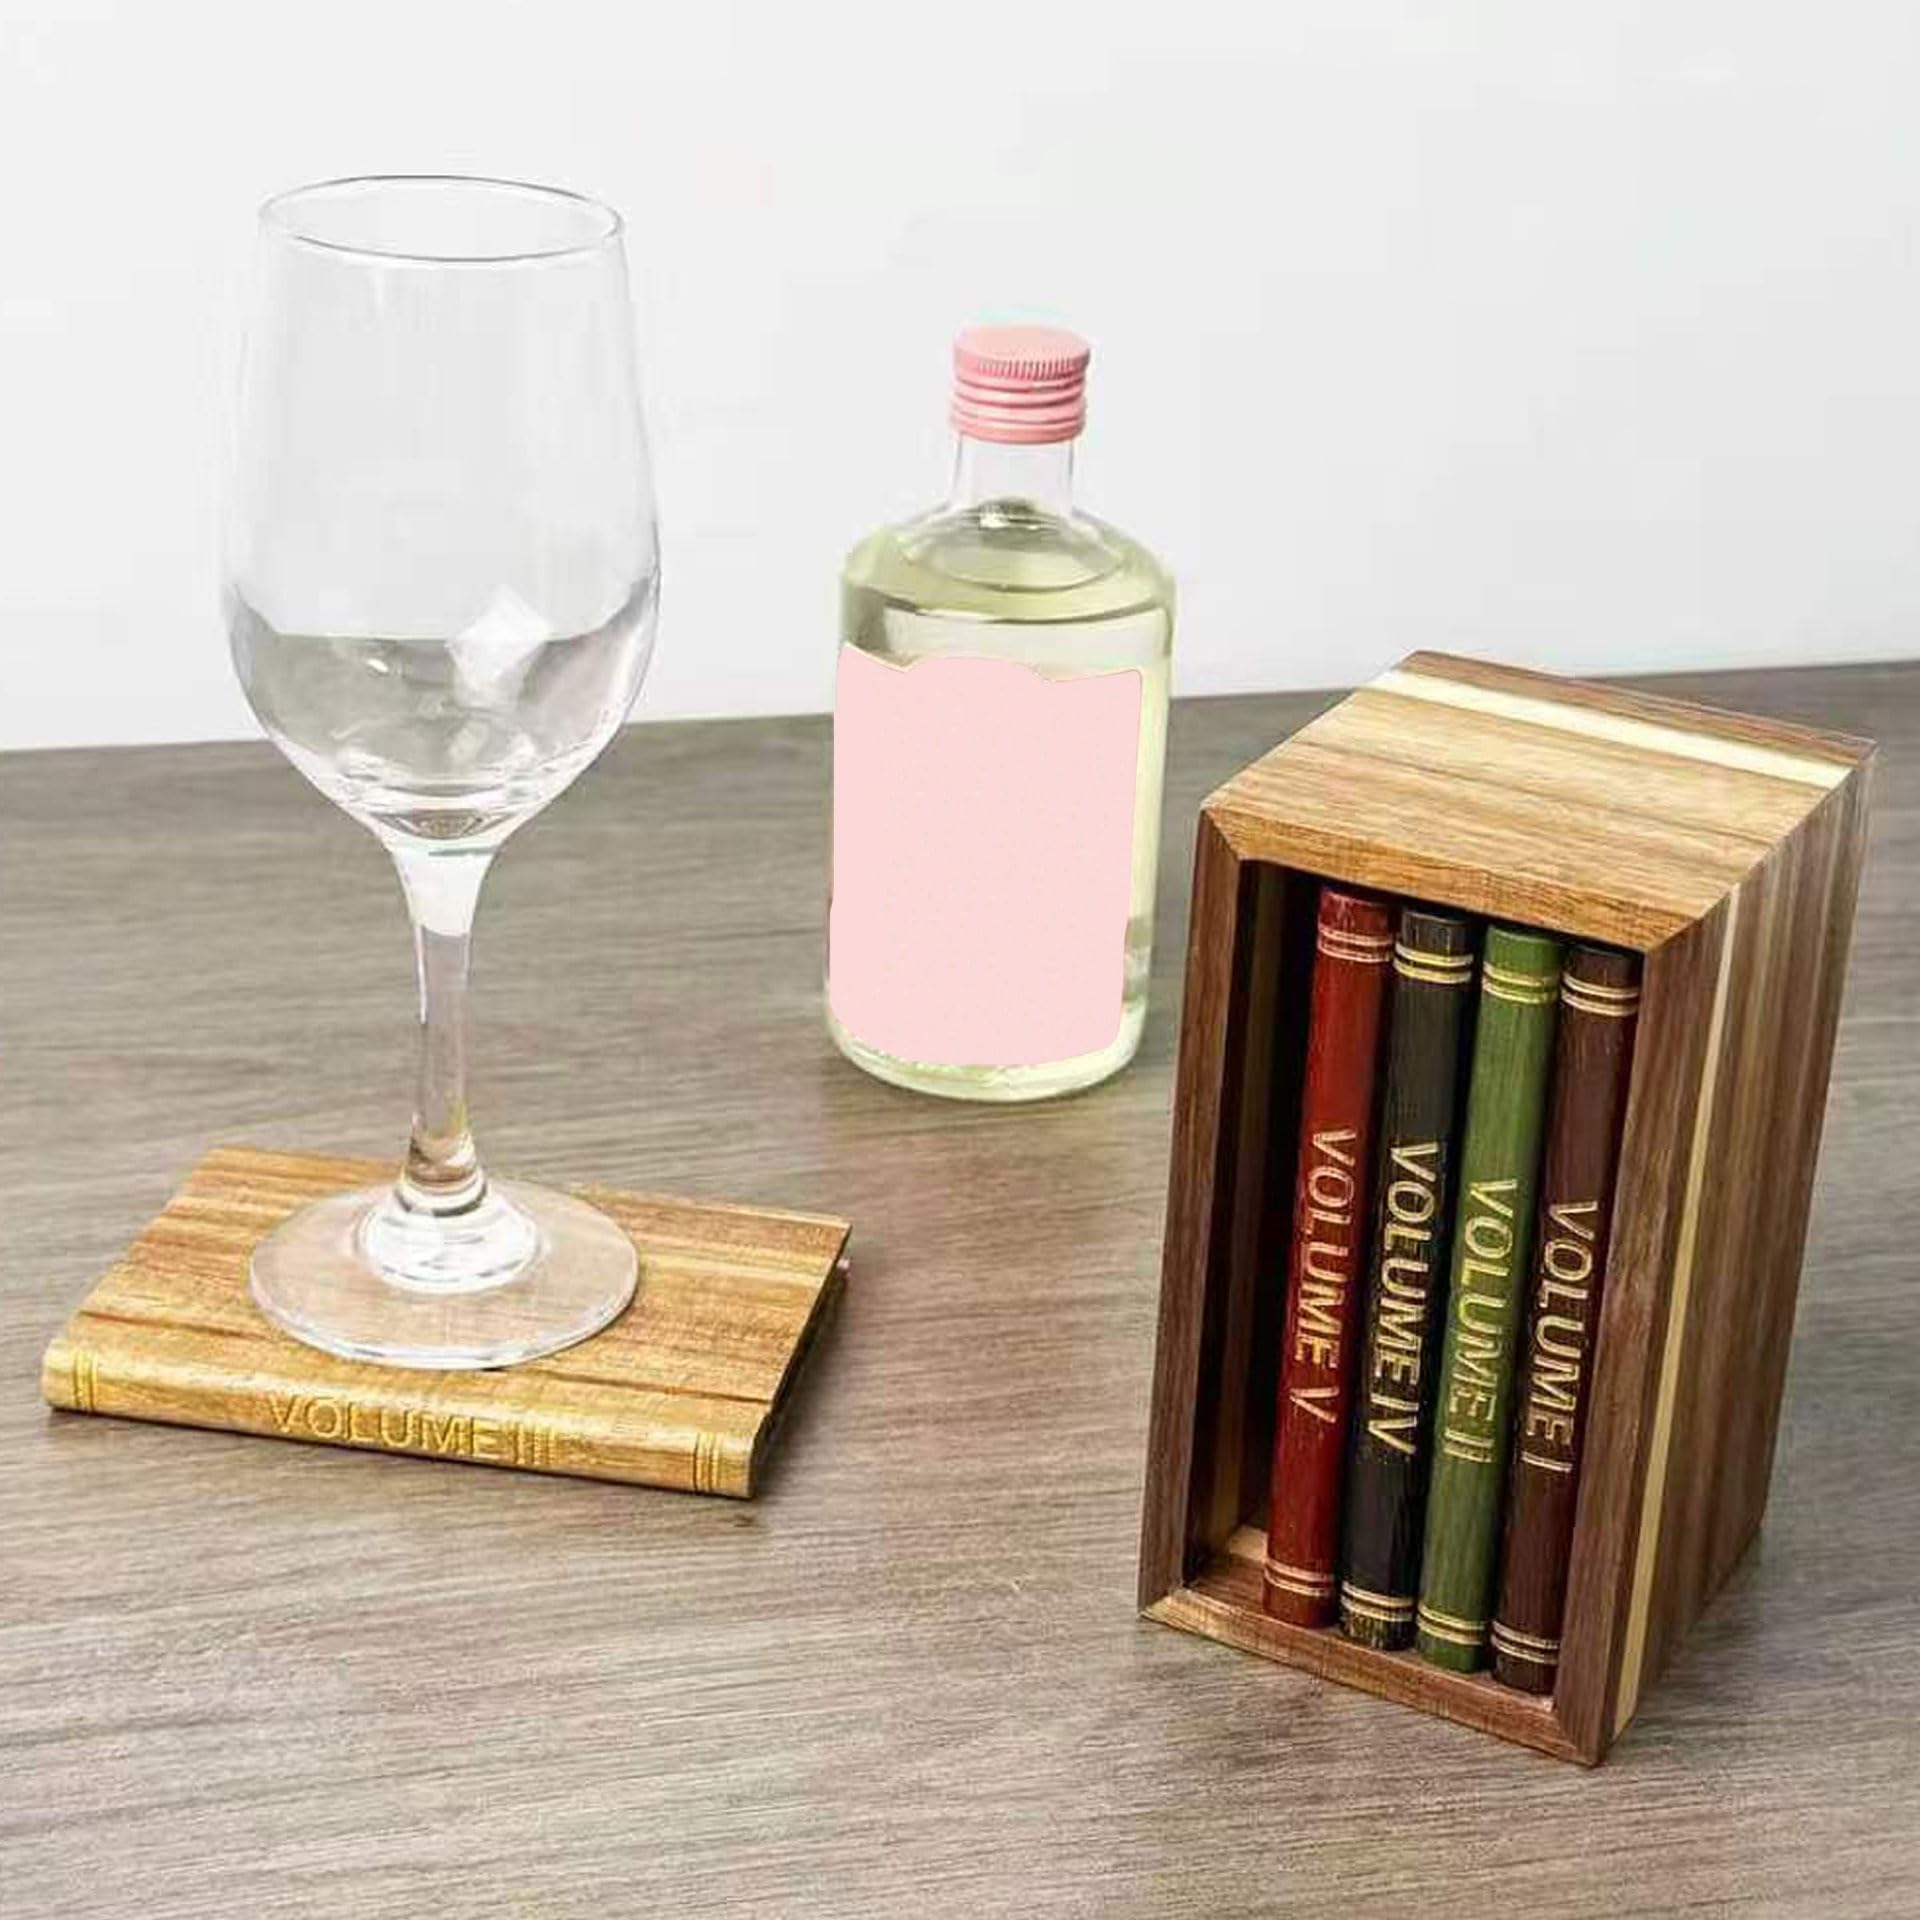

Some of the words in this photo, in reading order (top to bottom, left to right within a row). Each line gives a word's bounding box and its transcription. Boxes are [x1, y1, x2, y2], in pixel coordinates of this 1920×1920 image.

[1294, 1128, 1357, 1370] VOLUME
[1375, 1141, 1440, 1386] VOLUME
[1448, 1178, 1518, 1422] VOLUME
[1526, 1201, 1599, 1447] VOLUME
[267, 1394, 501, 1461] VOLUME
[512, 1421, 556, 1465] III
[1289, 1385, 1340, 1424] V
[1367, 1391, 1420, 1455] IV
[1443, 1427, 1495, 1464] II
[1520, 1451, 1572, 1473] I
